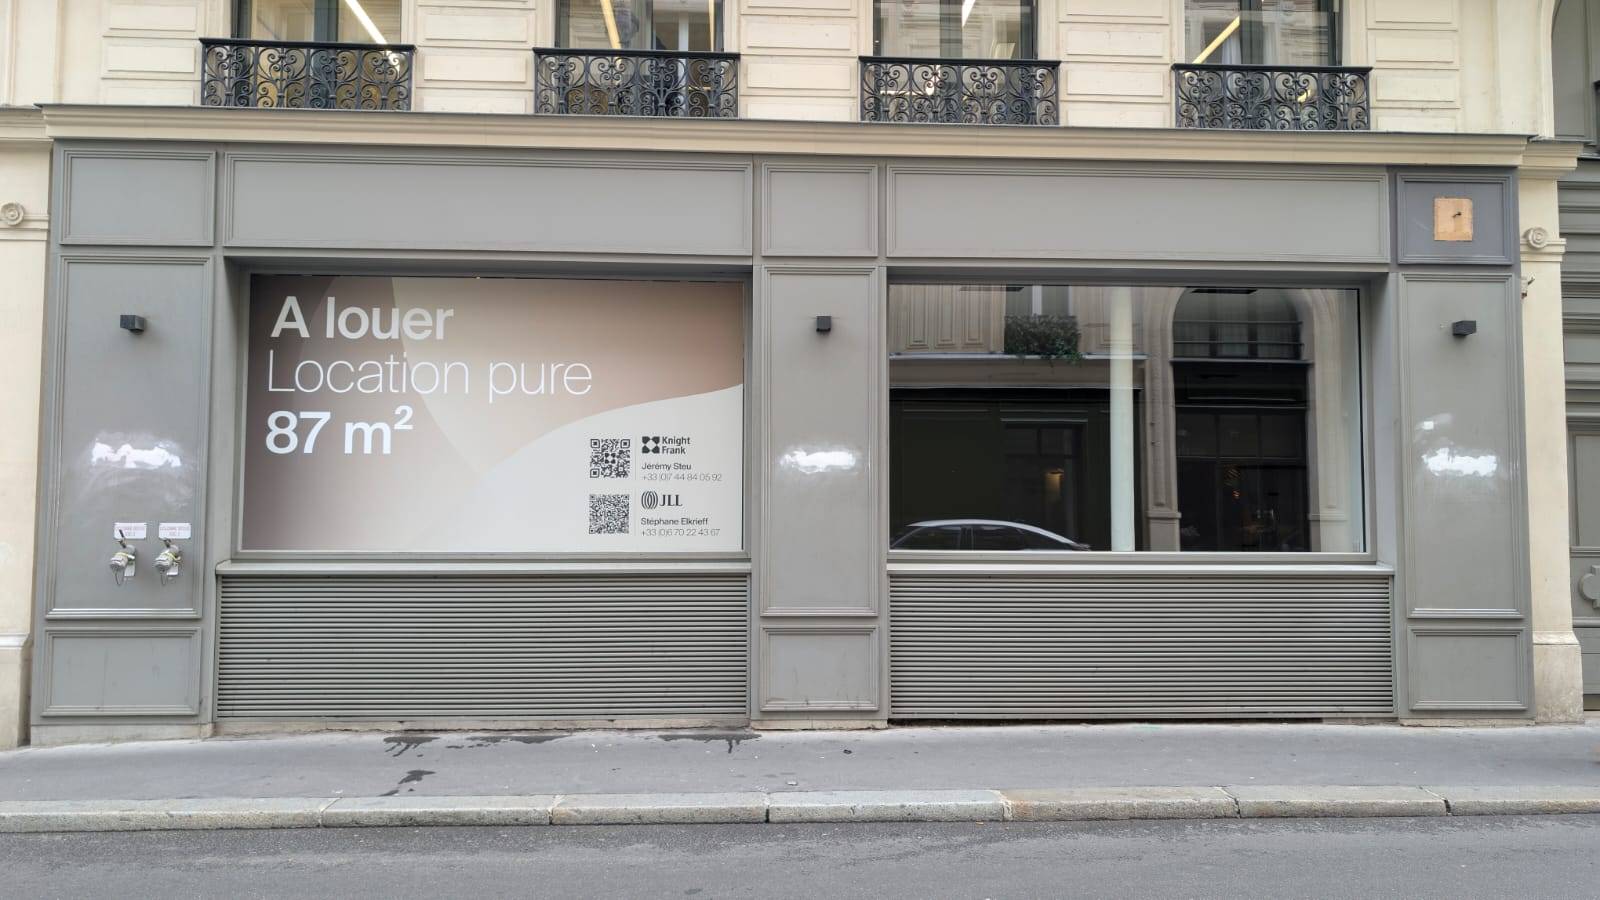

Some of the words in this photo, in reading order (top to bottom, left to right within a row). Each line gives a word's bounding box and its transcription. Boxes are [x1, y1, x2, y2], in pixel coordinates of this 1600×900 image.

[270, 296, 311, 338] A
[326, 296, 454, 341] louer
[268, 349, 470, 395] Location
[488, 361, 592, 403] pure
[265, 410, 331, 454] 87
[344, 405, 414, 454] m²
[662, 436, 691, 447] Knight
[662, 446, 686, 455] Frank
[673, 462, 692, 470] Steu
[642, 473, 658, 481] +33
[687, 473, 698, 481] 84
[711, 473, 722, 482] 92
[659, 494, 683, 507] JLL
[641, 528, 657, 536] +33
[686, 528, 697, 536] 22
[698, 528, 709, 536] 43
